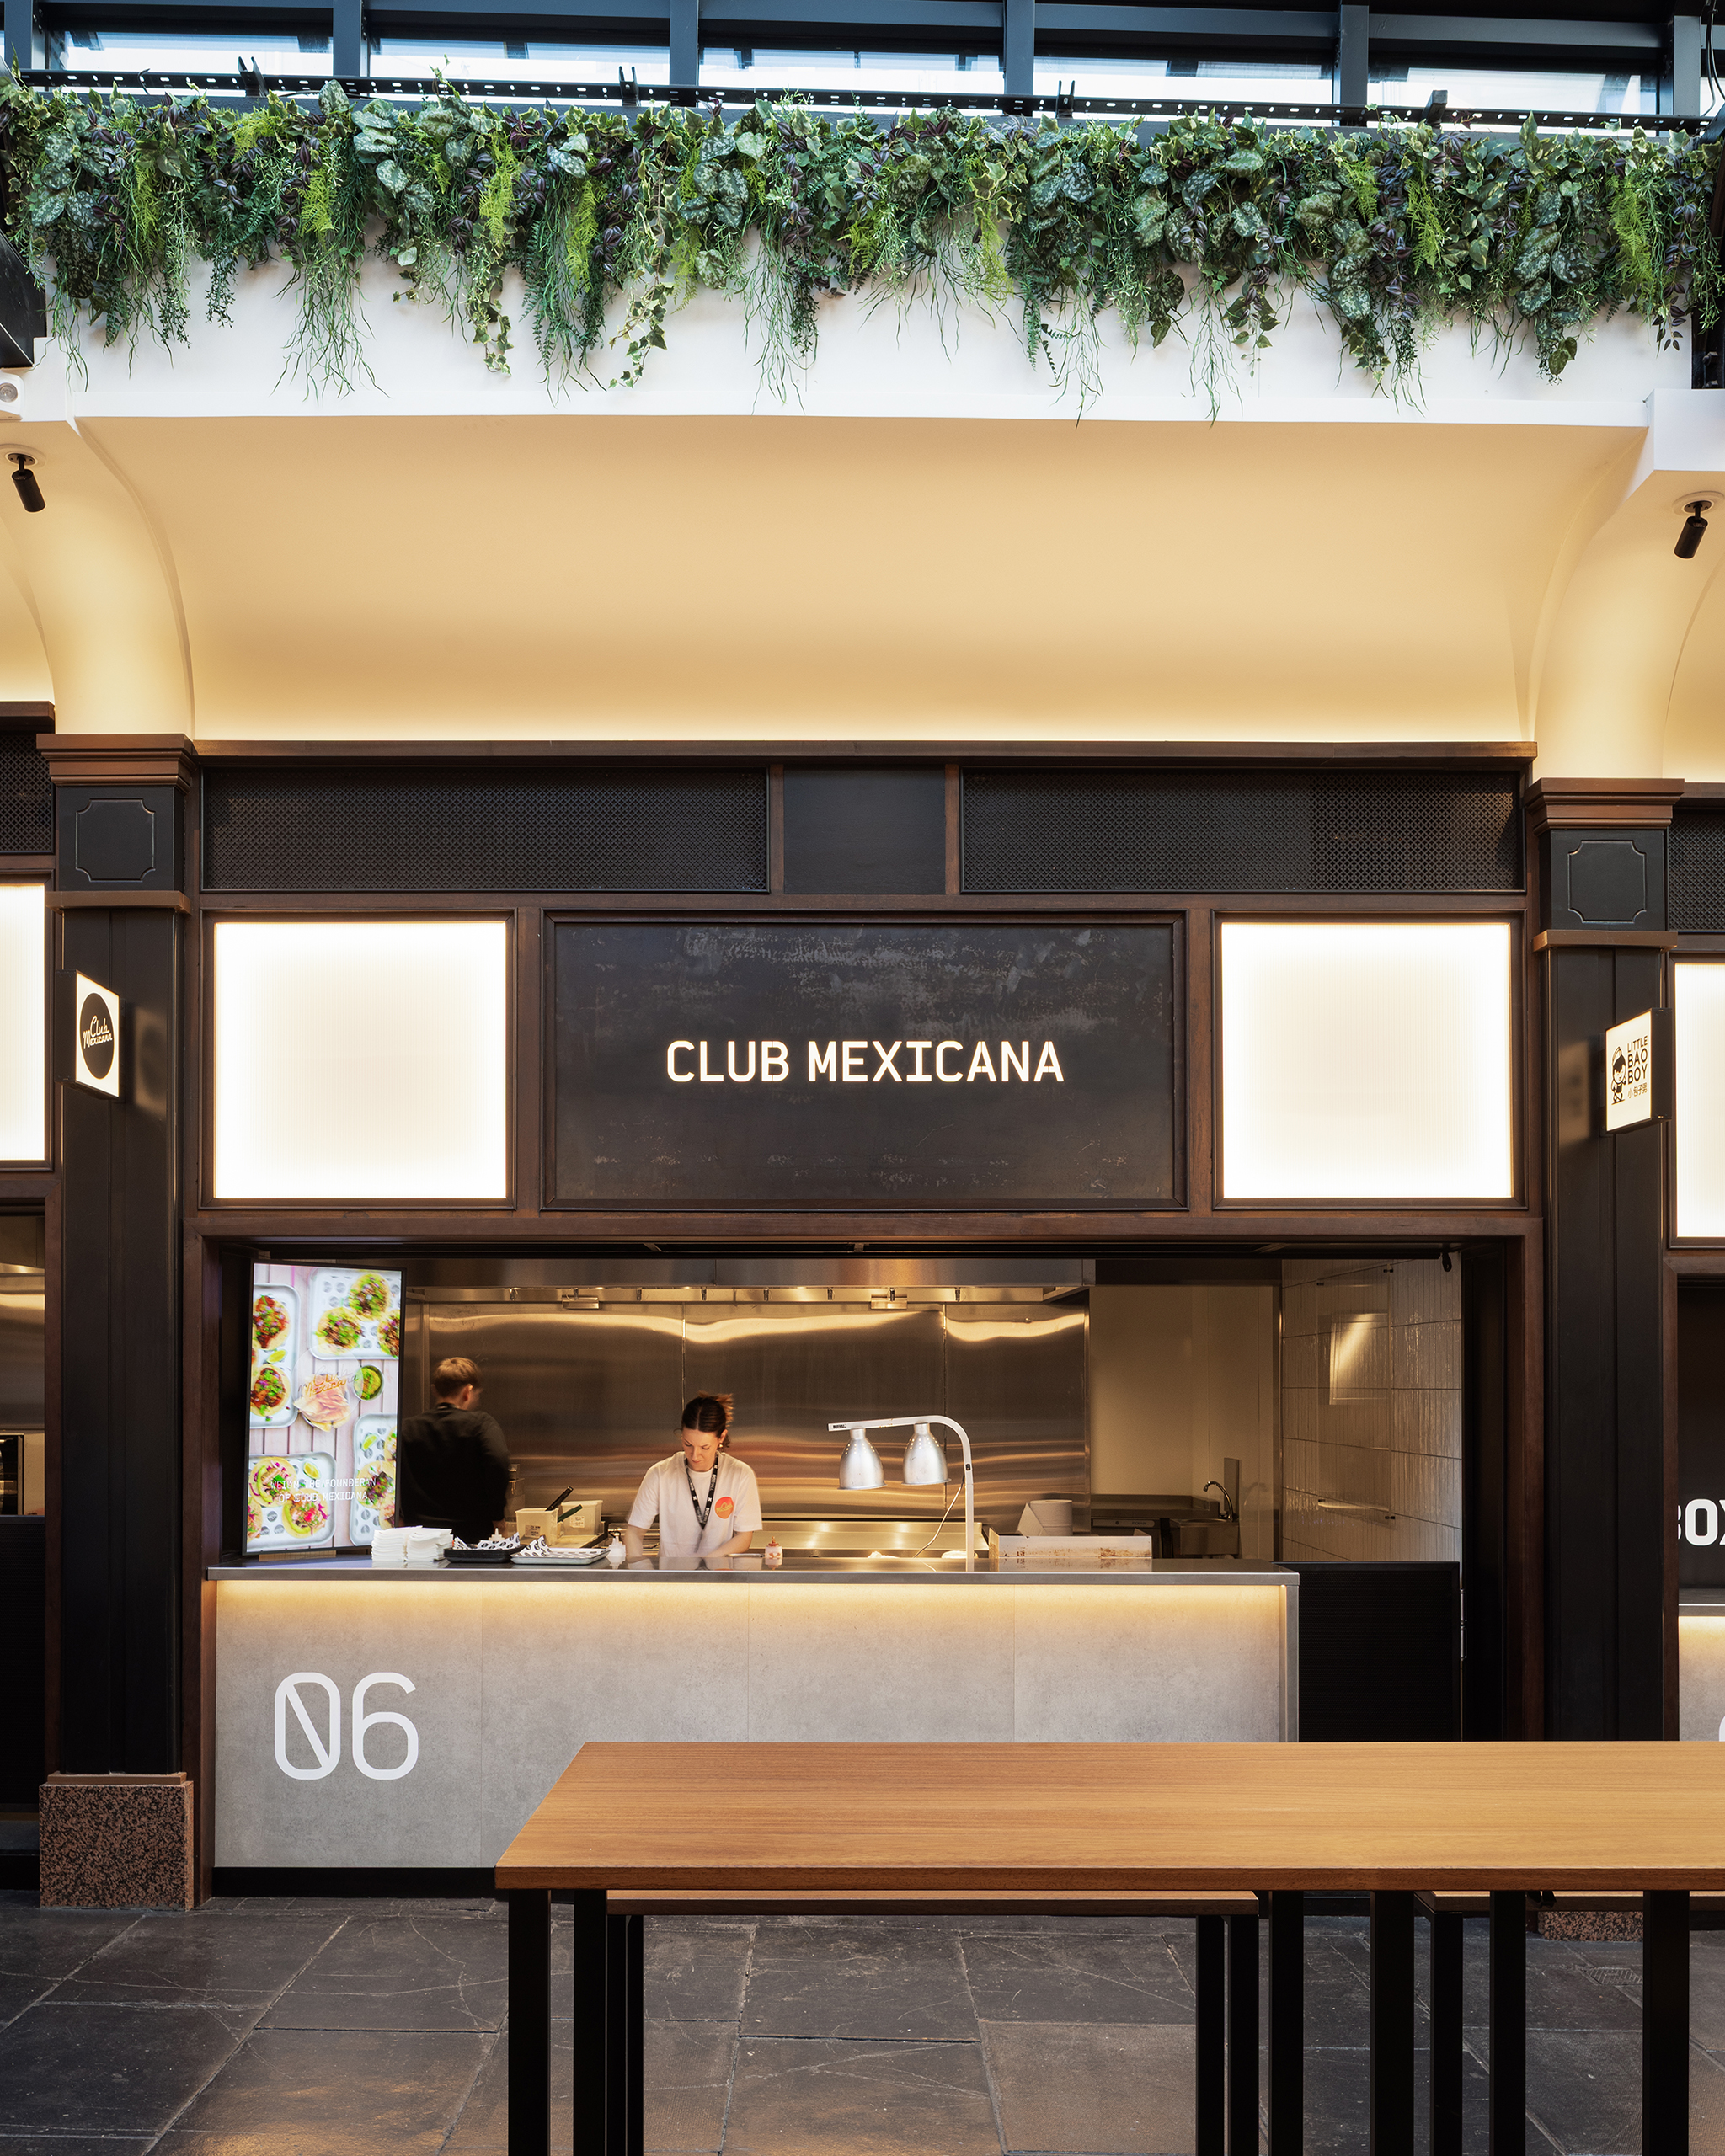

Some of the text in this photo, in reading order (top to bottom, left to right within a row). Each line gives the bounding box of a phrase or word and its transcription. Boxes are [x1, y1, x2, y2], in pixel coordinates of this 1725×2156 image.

[90, 1015, 110, 1038] Club
[83, 1029, 113, 1049] Mexicana
[1627, 1035, 1648, 1053] LITTLE
[667, 1040, 1065, 1082] CLUB MEXICANA
[1627, 1048, 1648, 1069] BAO
[1627, 1063, 1648, 1085] BOY
[274, 1672, 419, 1780] 06
